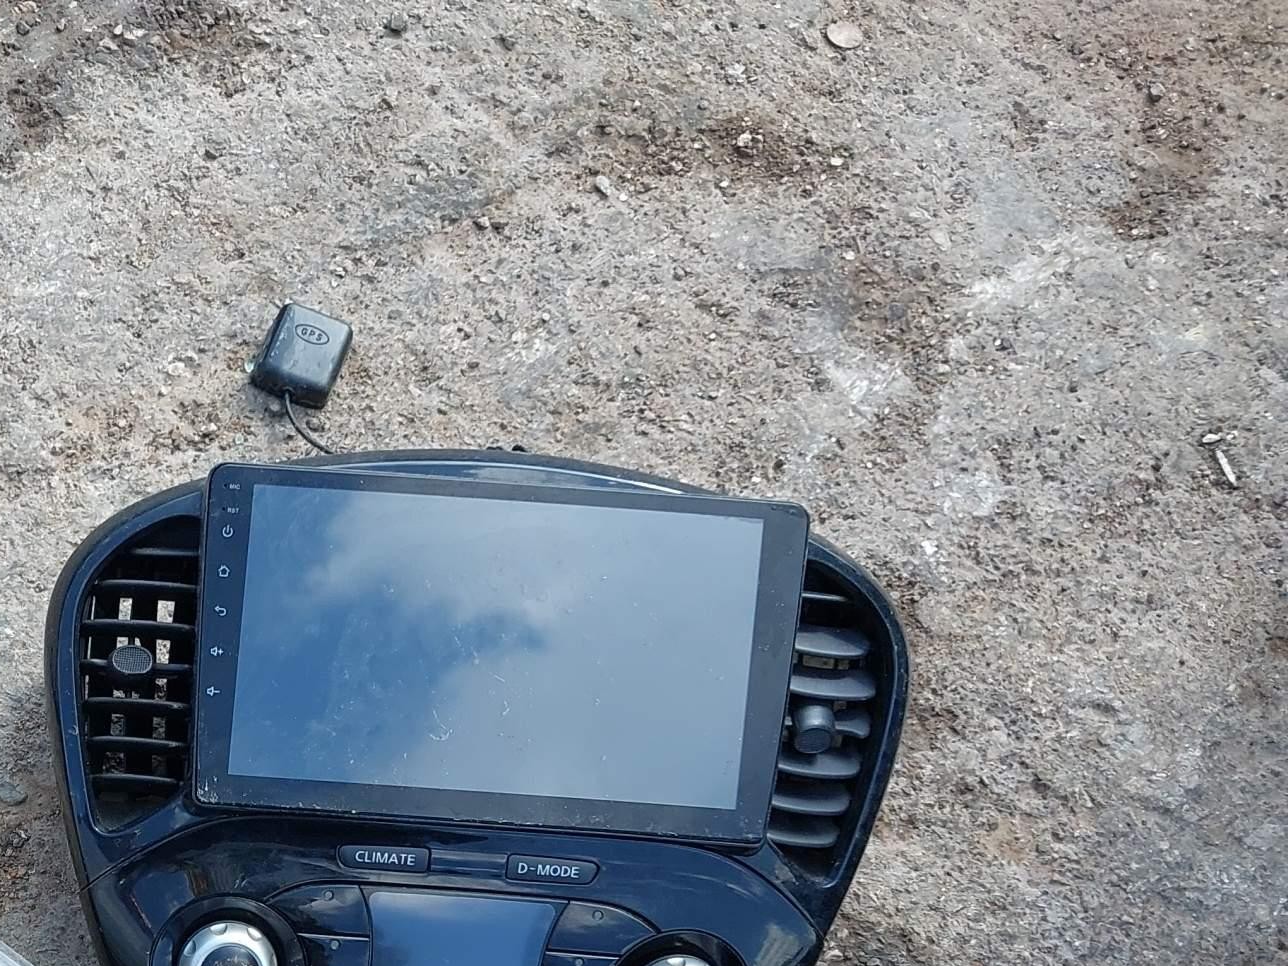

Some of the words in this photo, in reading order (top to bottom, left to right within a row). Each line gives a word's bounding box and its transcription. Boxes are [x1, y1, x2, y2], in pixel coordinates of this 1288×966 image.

[301, 328, 324, 341] GPS
[355, 850, 416, 866] CLIMATE
[517, 862, 580, 878] D-MODE
